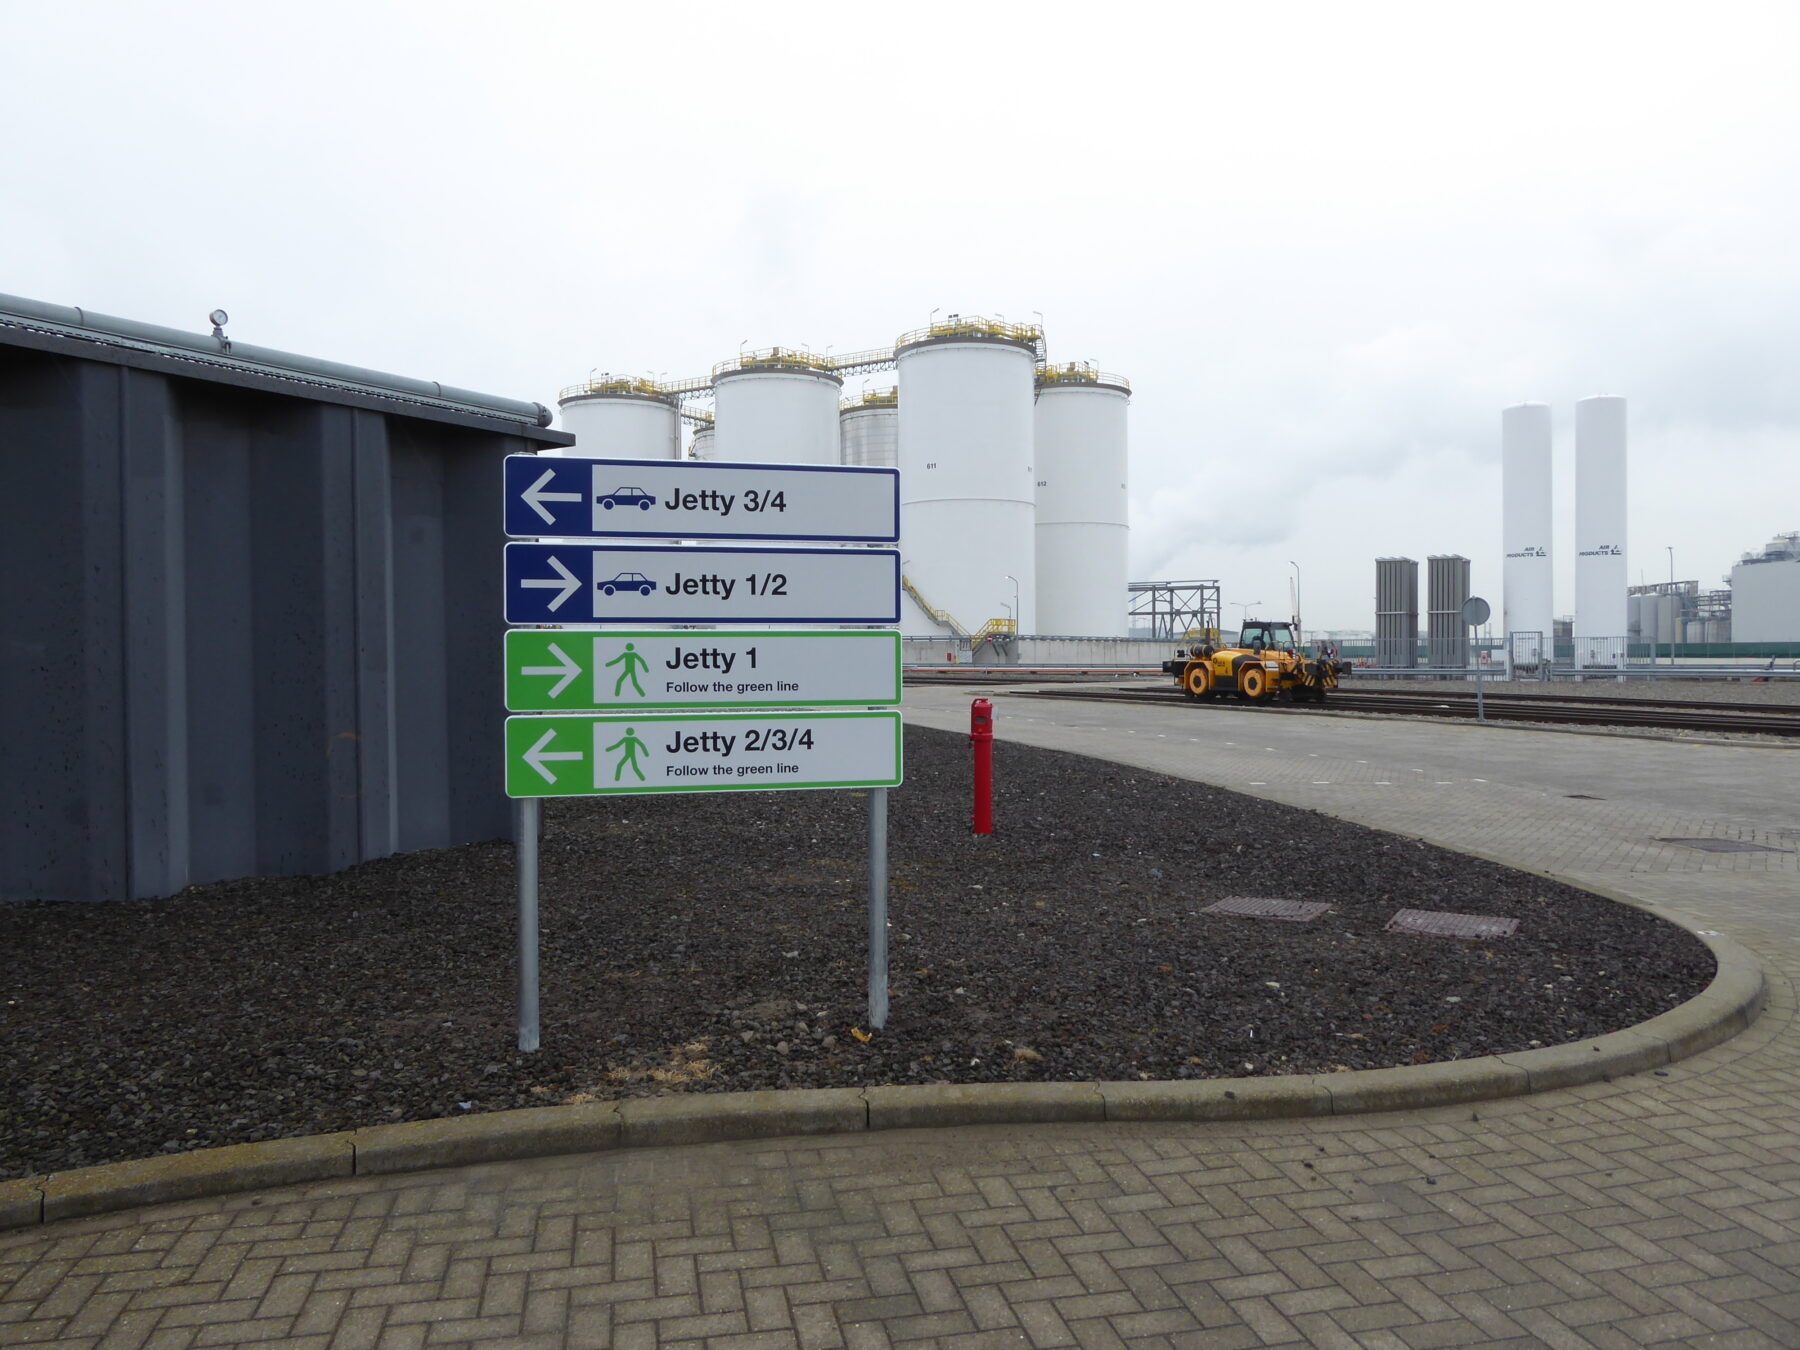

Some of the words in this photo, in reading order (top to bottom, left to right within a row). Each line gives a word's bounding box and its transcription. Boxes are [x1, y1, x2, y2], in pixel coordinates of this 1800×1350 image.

[665, 487, 735, 517] Jetty
[743, 489, 787, 513] 3/4
[665, 572, 736, 601] Jetty
[745, 573, 787, 596] 1/2
[665, 647, 737, 674] Jetty
[745, 647, 756, 669] 1
[666, 681, 709, 693] Follow
[712, 681, 733, 692] the
[736, 683, 773, 695] green
[776, 680, 799, 692] line
[665, 730, 737, 758] Jetty
[744, 728, 815, 752] 2/3/4
[666, 765, 709, 777] Follow
[712, 764, 733, 775] the
[736, 766, 773, 778] green
[776, 763, 799, 775] line
